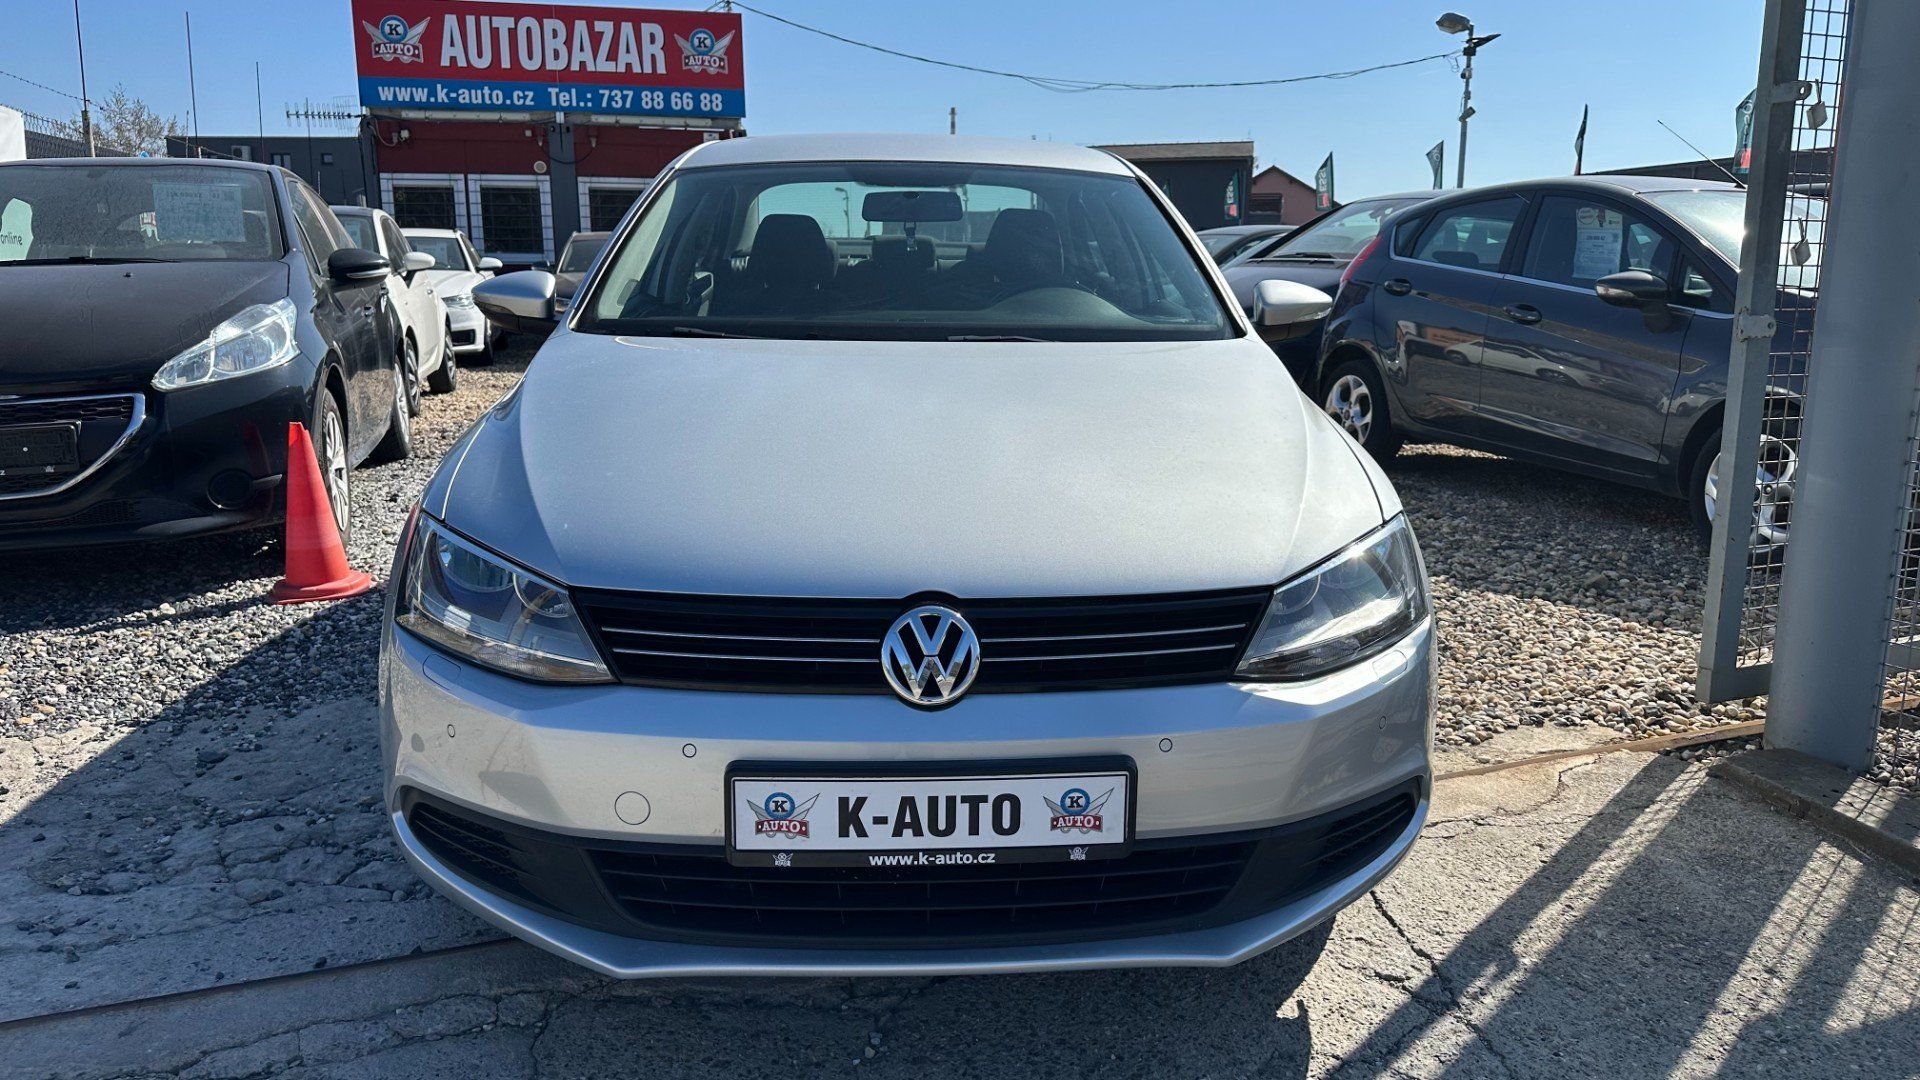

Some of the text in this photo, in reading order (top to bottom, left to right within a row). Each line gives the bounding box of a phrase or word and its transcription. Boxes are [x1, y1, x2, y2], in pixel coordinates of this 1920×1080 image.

[387, 23, 402, 37] K
[440, 14, 667, 75] AUTOBAZAR
[695, 36, 709, 49] K
[379, 43, 414, 56] AUTO
[688, 55, 720, 67] AUTO
[378, 84, 723, 111] www.k-auto.cz Tel.: 737 88 66 88
[772, 800, 788, 813] K
[1067, 795, 1084, 809] K
[838, 793, 1021, 838] K-AUTO
[1057, 815, 1095, 828] AUTO
[762, 821, 801, 833] AUTO
[869, 851, 996, 866] www.k-auto.cz
